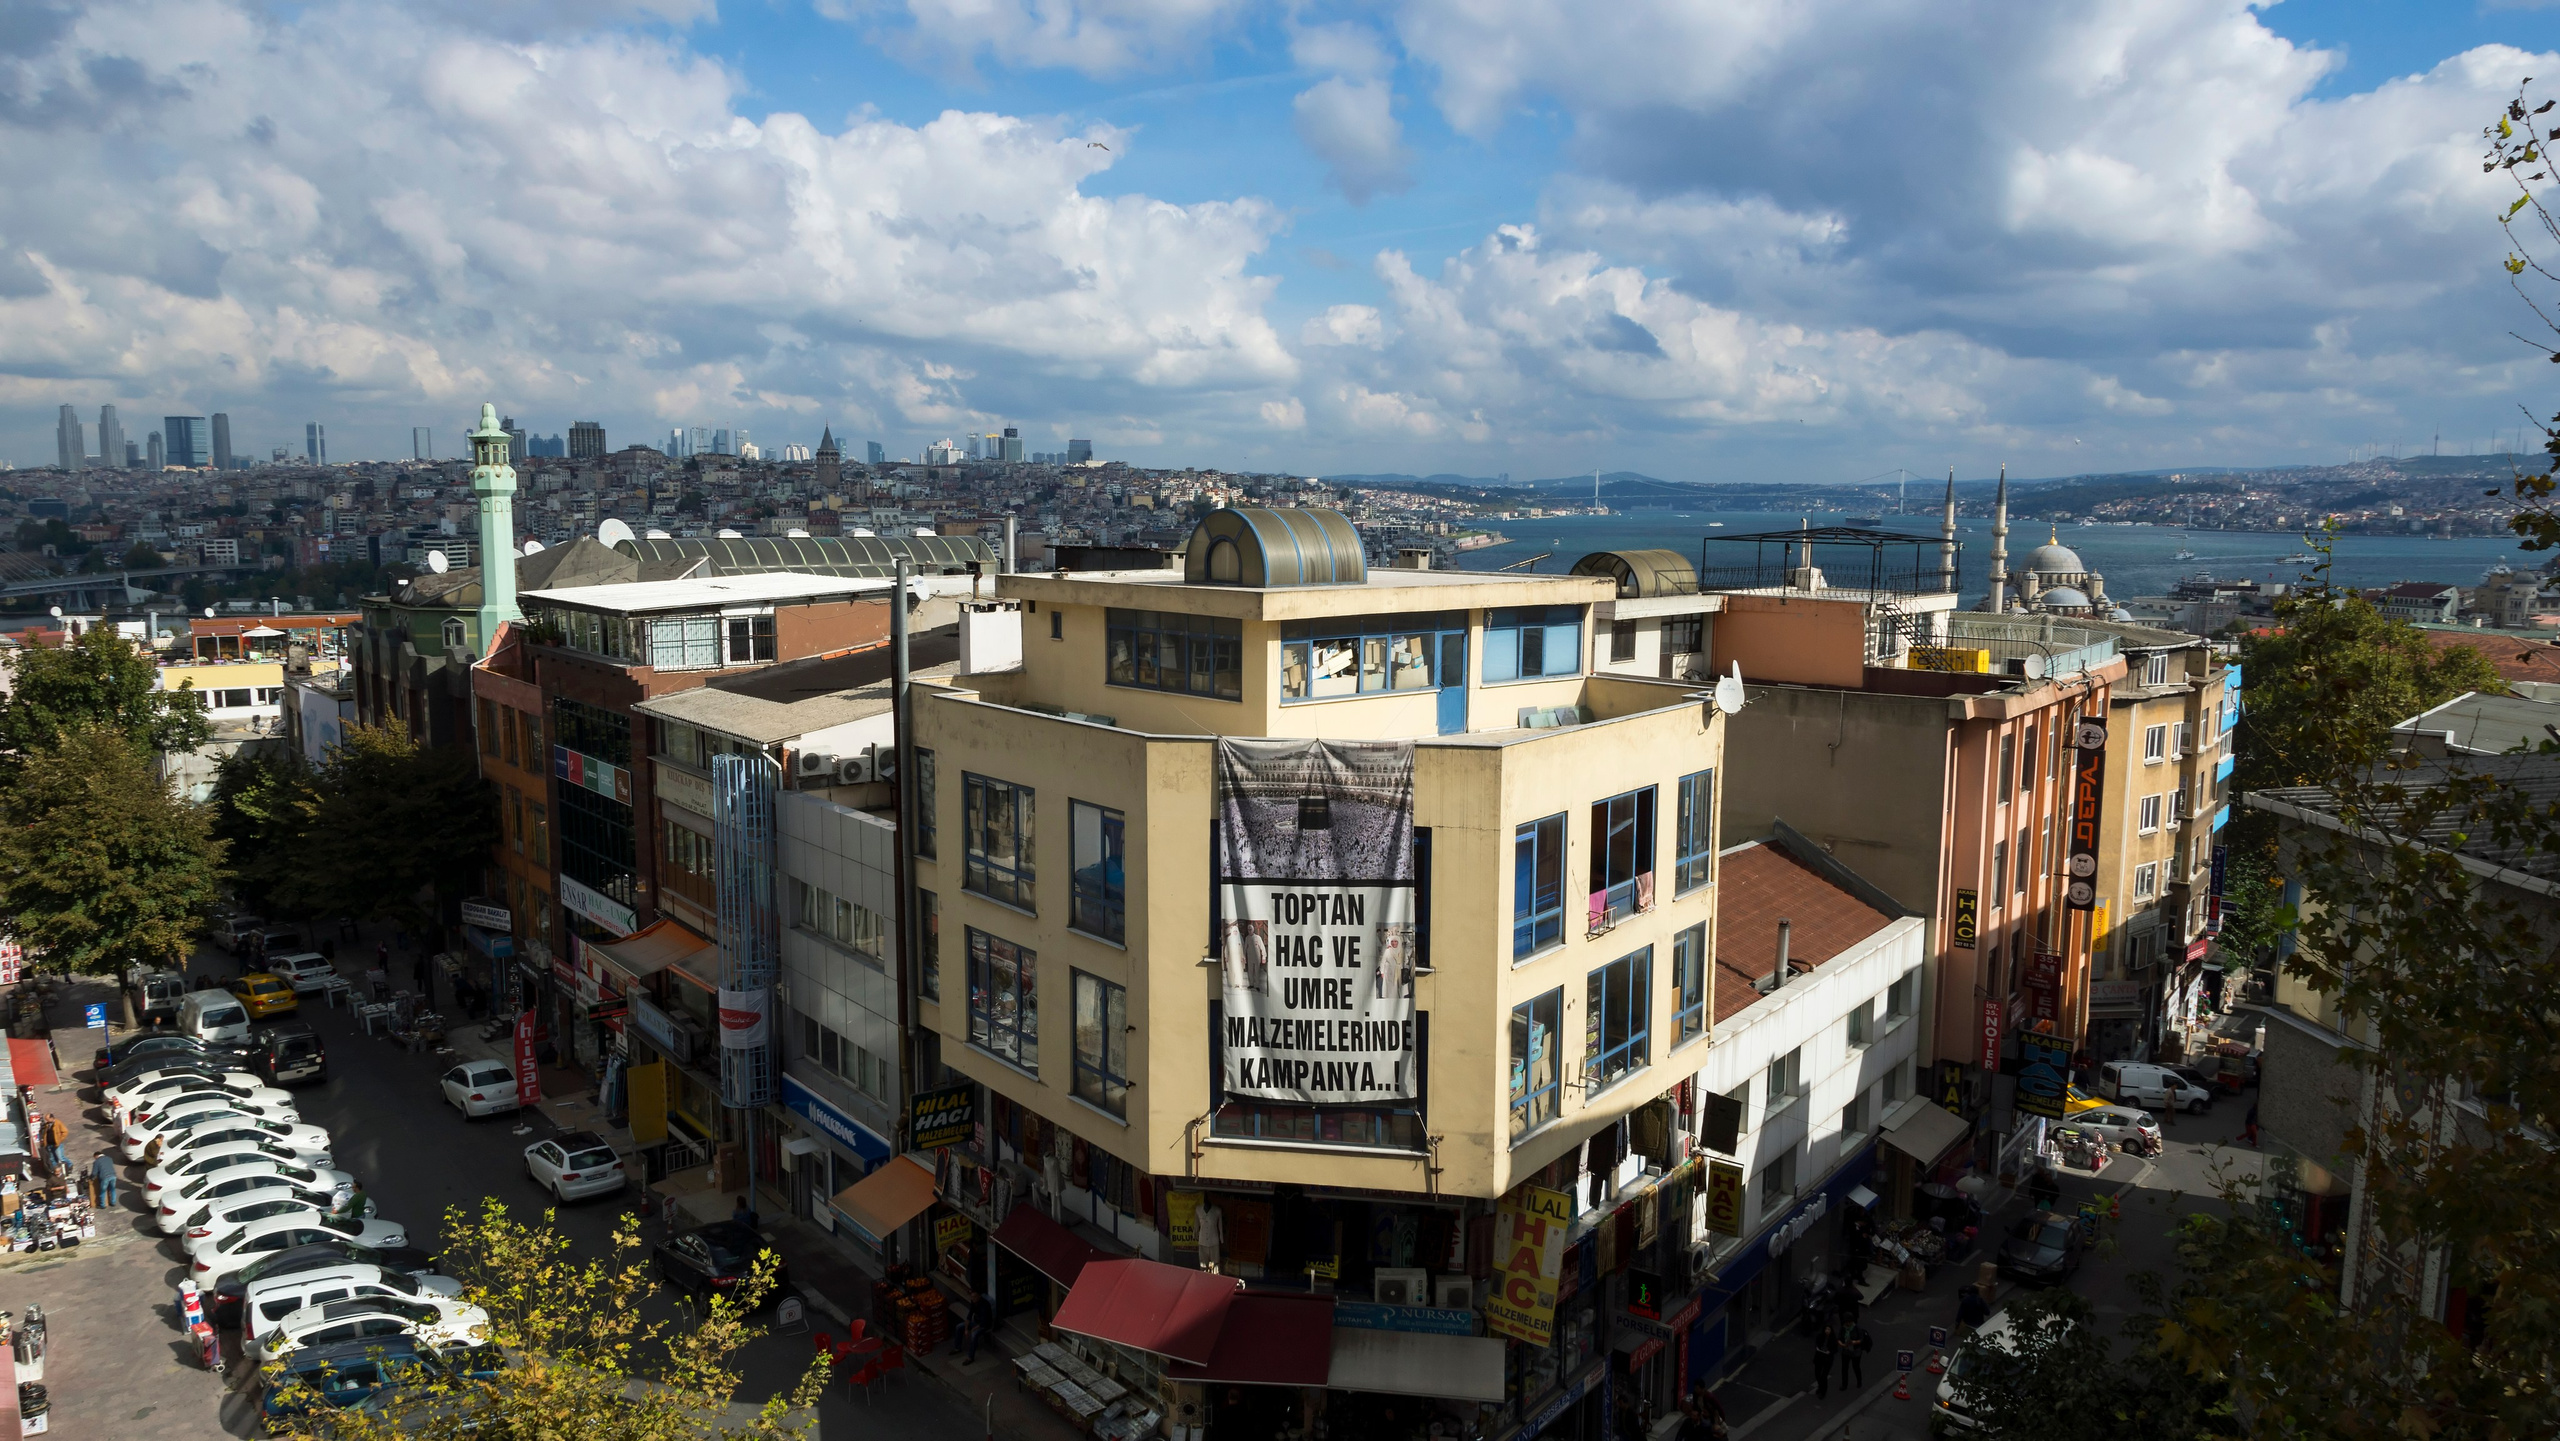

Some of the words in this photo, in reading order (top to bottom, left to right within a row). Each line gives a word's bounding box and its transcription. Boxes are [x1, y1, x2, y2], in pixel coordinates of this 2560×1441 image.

[562, 881, 588, 912] ENSAR
[588, 893, 605, 912] HAC
[1271, 892, 1365, 926] TOPTAN
[1957, 897, 1976, 939] HAC
[1275, 935, 1324, 969] HAC
[1332, 935, 1362, 969] VE
[2039, 955, 2057, 965] 35.
[1284, 978, 1354, 1010] UMRE
[2036, 963, 2056, 1018] NER
[1228, 1011, 1413, 1052] MALZEMELERİNDE
[1984, 1016, 1998, 1070] NOTER
[2020, 1033, 2073, 1052] AKABE
[519, 1021, 537, 1097] hisar
[1240, 1058, 1401, 1092] KAMPANYA..!
[2017, 1043, 2067, 1097] HAC
[915, 1106, 972, 1131] HACI
[916, 1091, 969, 1116] HİLAL
[816, 1107, 857, 1147] HALKBANK
[1712, 1173, 1736, 1221] HAC
[938, 1215, 970, 1235] HAC
[1507, 1212, 1546, 1309] HAC
[1401, 1307, 1468, 1324] NURSAÇ
[1488, 1301, 1552, 1332] MALZEMELERİ
[1616, 1315, 1670, 1340] PORSELEN
[1537, 1392, 1571, 1425] PORSELEN
